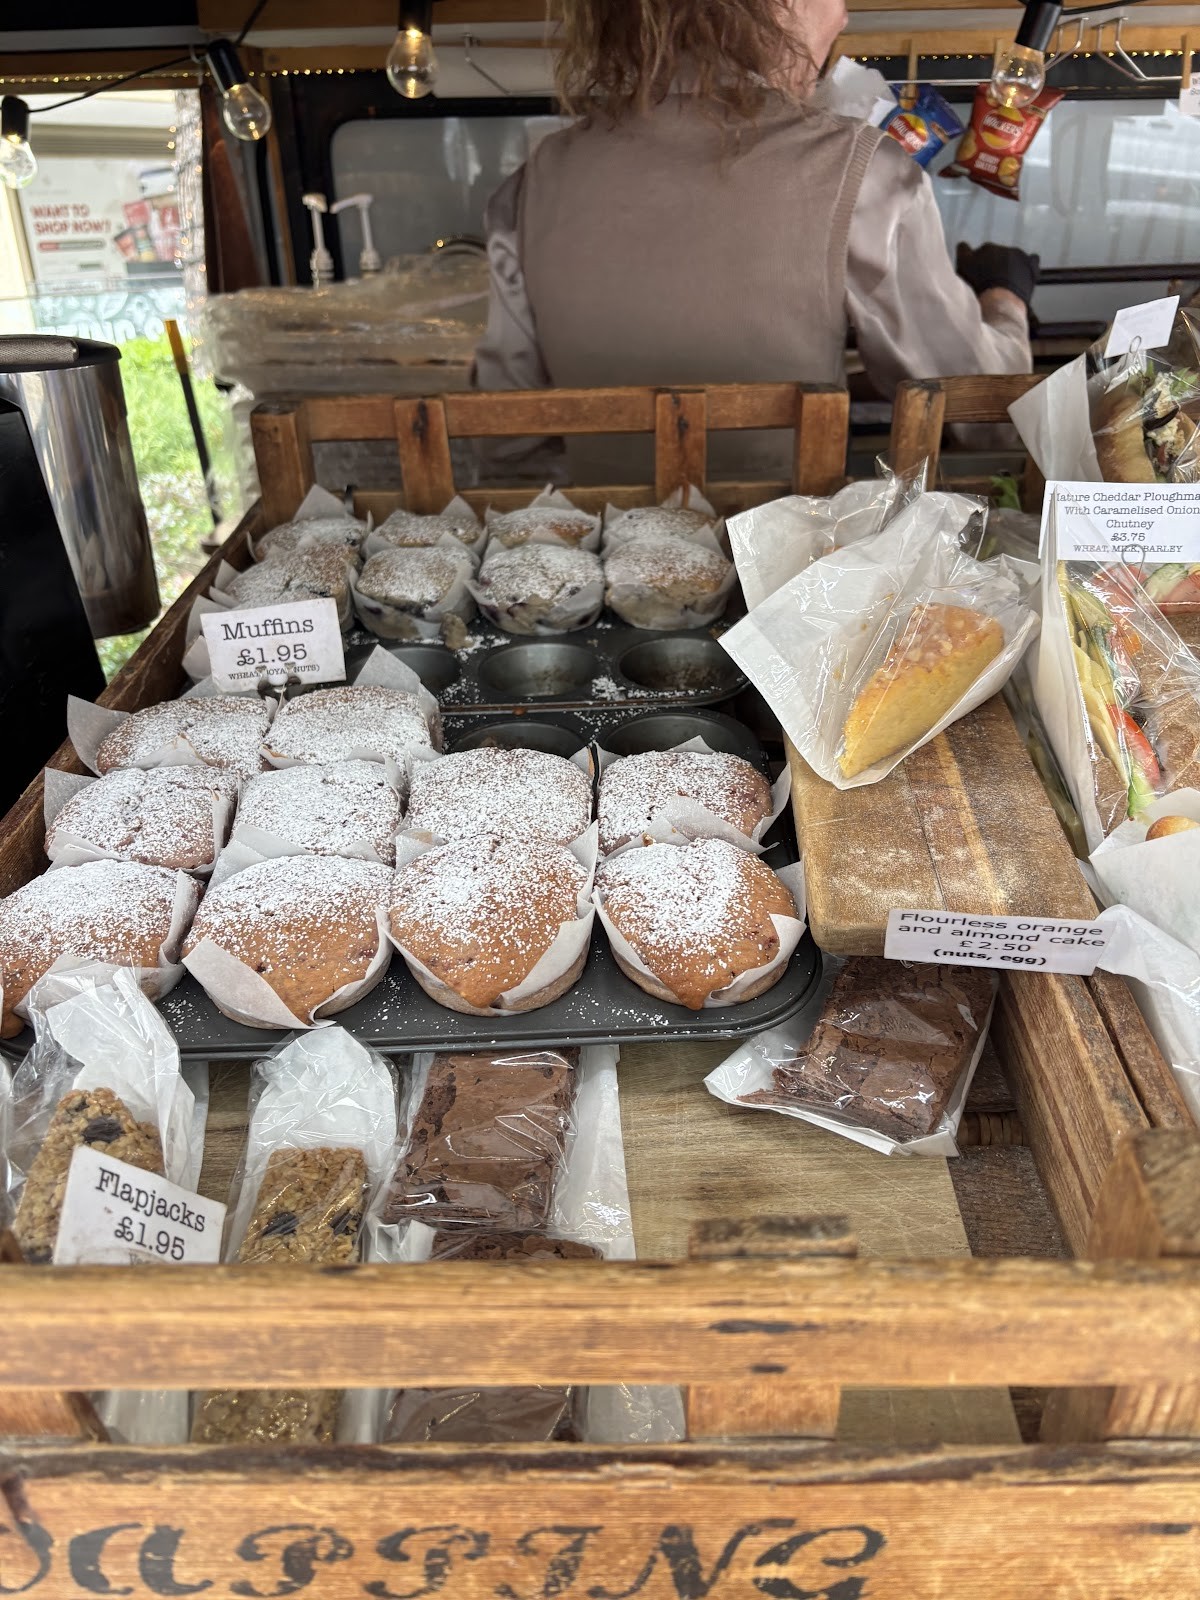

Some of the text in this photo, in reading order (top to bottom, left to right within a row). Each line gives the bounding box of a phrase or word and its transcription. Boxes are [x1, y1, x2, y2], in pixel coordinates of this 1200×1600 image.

[31, 203, 90, 217] WANT TO
[34, 221, 68, 234] SHOP
[1093, 492, 1141, 502] Cheddar
[1064, 505, 1200, 515] With Caramelised Onion
[1106, 519, 1155, 531] Chutney
[1110, 532, 1146, 542] £3.75
[1073, 544, 1110, 553] WHEAT,
[1143, 544, 1183, 553] BARLEY
[221, 618, 314, 641] Muffins
[236, 643, 307, 667] £1.95
[900, 913, 1103, 936] Flourless orange
[898, 924, 1106, 947] and almond cake
[933, 948, 1047, 966] (nuts, egg)
[95, 1167, 206, 1232] Flapjacks
[114, 1216, 185, 1261] £1.95
